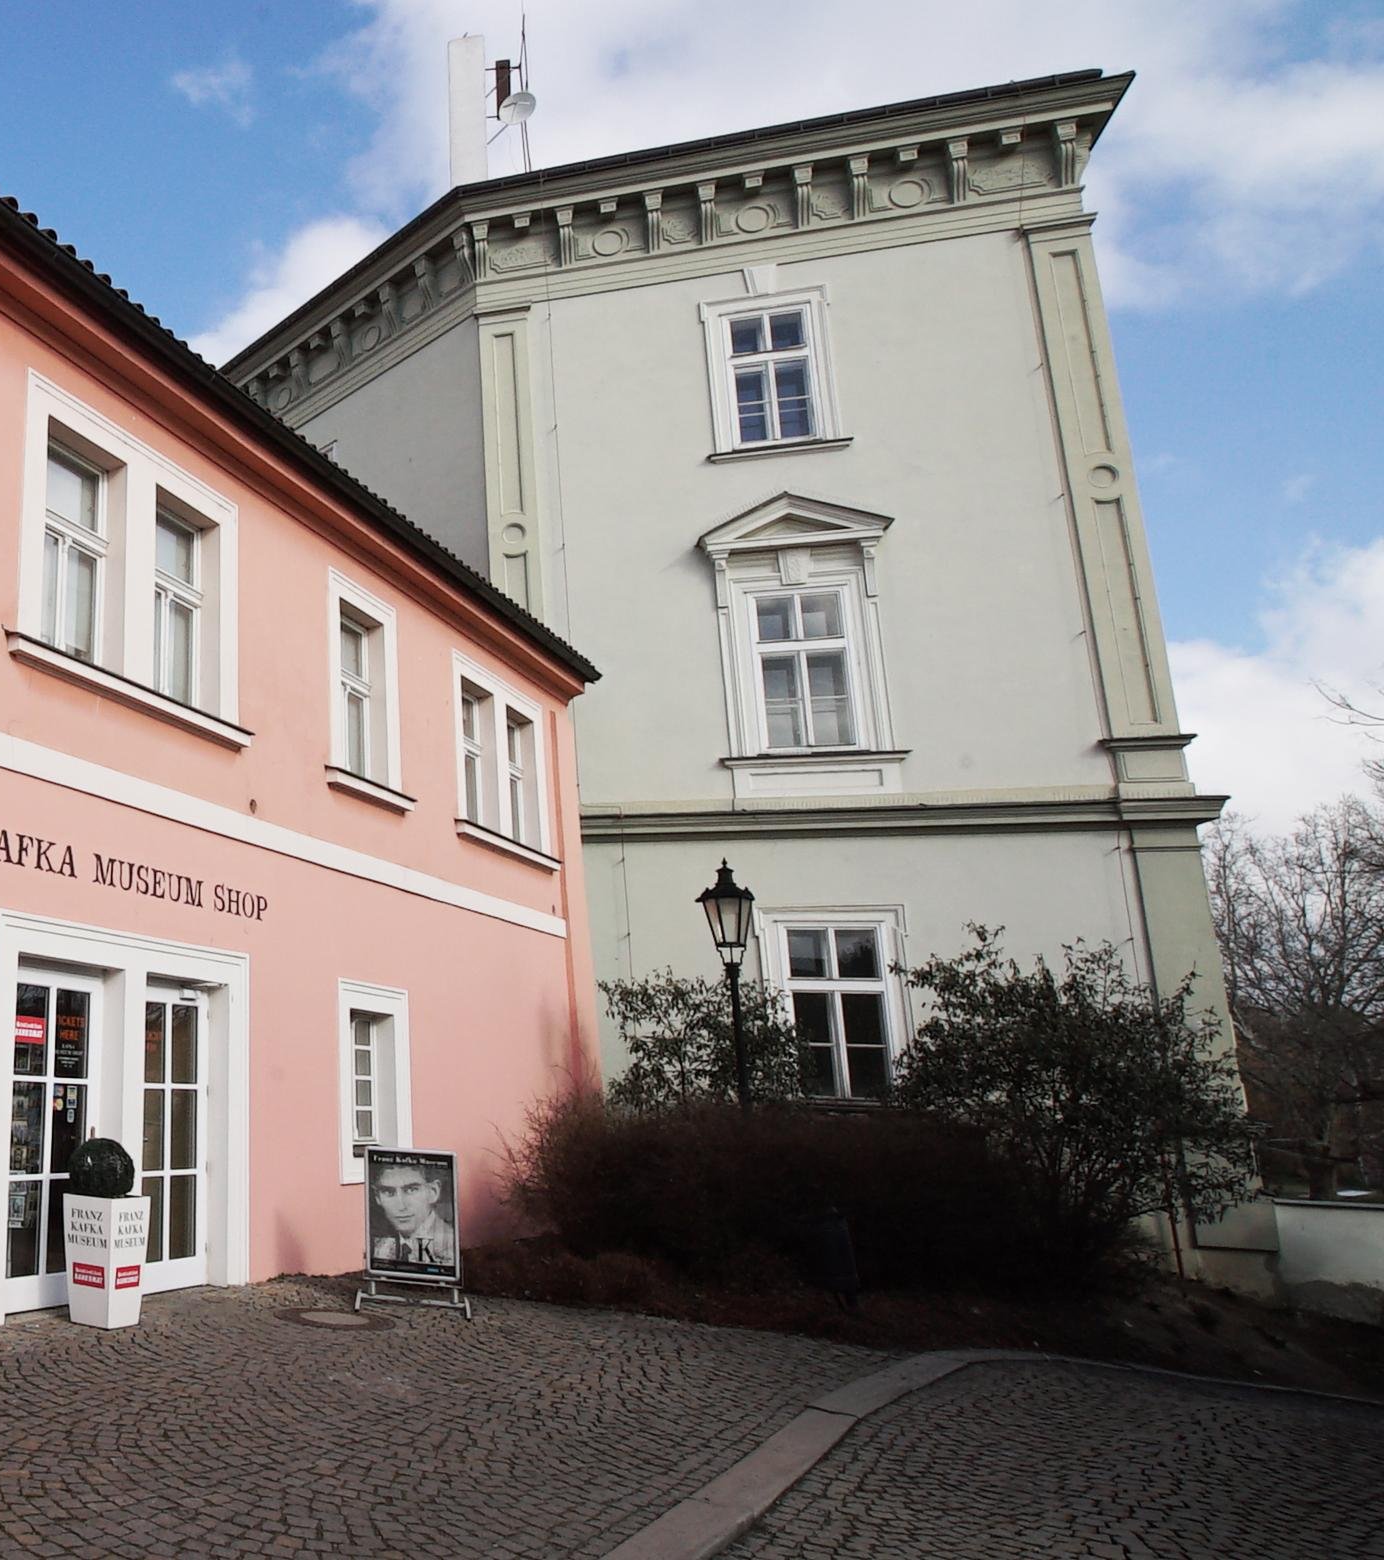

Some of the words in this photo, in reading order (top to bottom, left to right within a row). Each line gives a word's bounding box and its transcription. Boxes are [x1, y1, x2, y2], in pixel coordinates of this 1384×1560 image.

[92, 853, 204, 908] MUSEUM
[213, 884, 268, 921] SHOP
[71, 1208, 104, 1222] FRANZ
[118, 1210, 144, 1222] FRANZ
[71, 1221, 104, 1235] KAFKA
[118, 1224, 144, 1235] KAFKA
[67, 1233, 107, 1249] MUSEUM
[114, 1236, 146, 1249] MUSEUM
